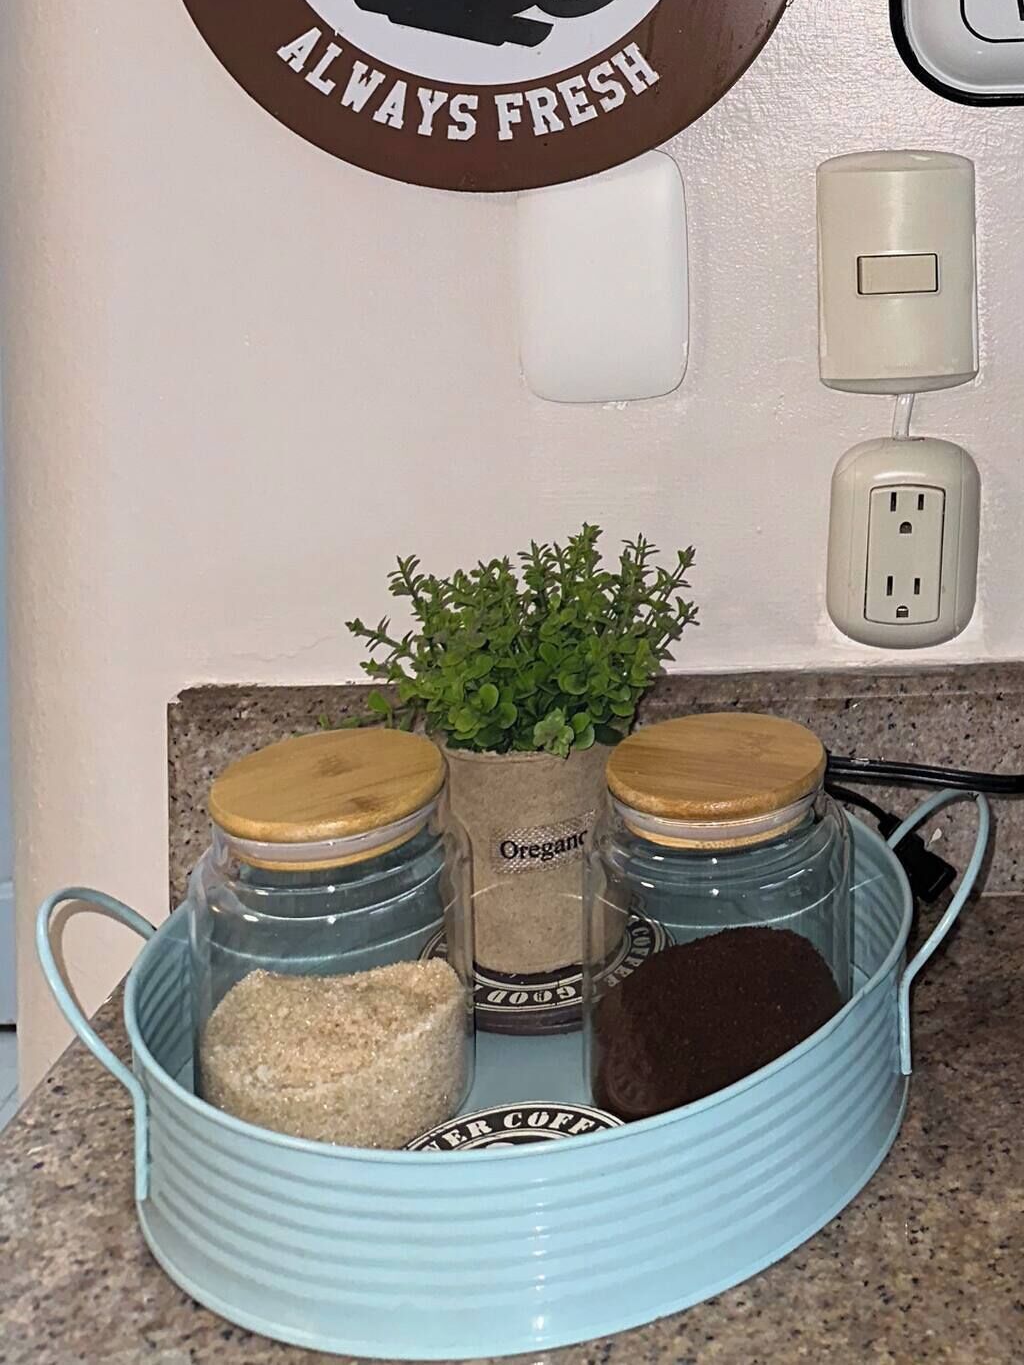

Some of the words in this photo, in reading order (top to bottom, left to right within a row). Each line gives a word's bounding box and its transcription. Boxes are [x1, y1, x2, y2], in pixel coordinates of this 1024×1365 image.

[275, 26, 479, 142] ALWAYS
[494, 41, 661, 142] FRESH
[487, 986, 577, 1005] GOOD
